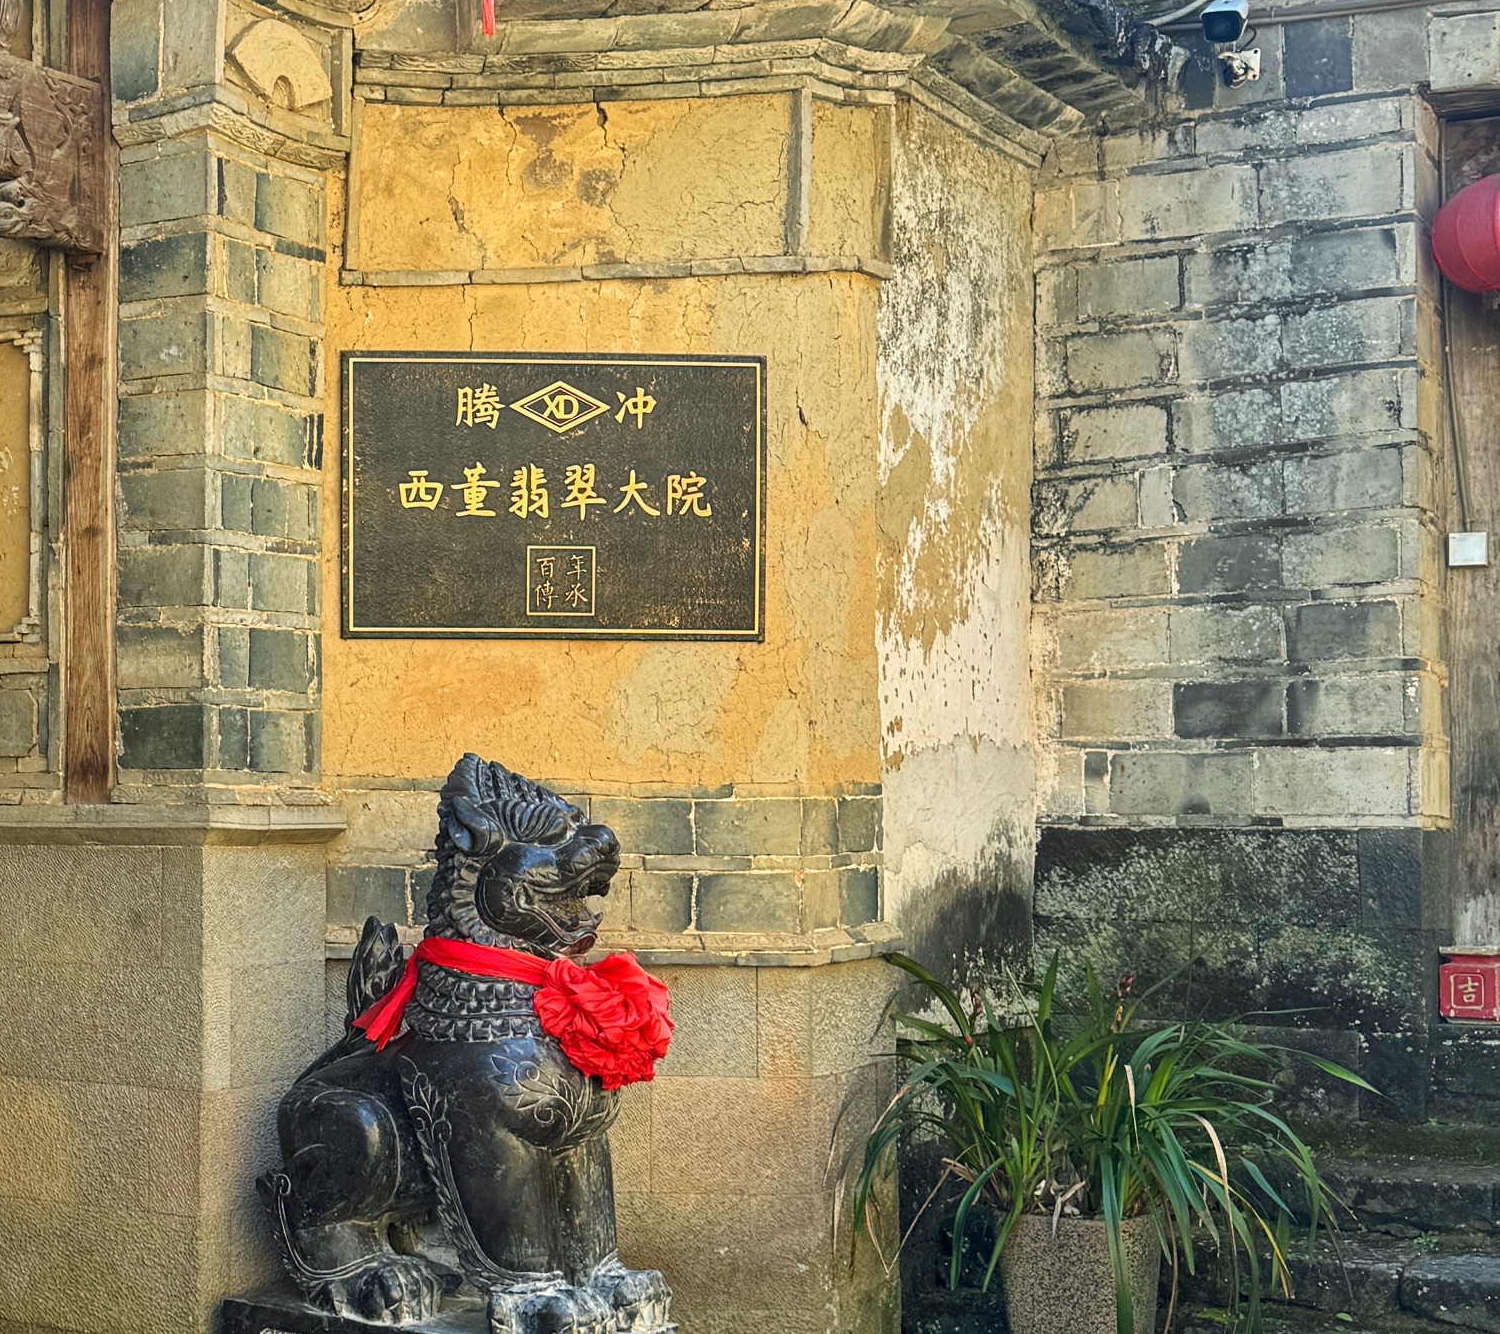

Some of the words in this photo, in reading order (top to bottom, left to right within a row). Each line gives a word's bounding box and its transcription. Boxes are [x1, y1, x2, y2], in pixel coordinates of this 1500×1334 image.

[455, 382, 506, 430] 腾
[541, 394, 580, 420] XD
[613, 386, 658, 430] 冲
[398, 462, 713, 522] 西董翡翠大院
[535, 554, 588, 581] 百年
[1457, 975, 1480, 1004] 吉
